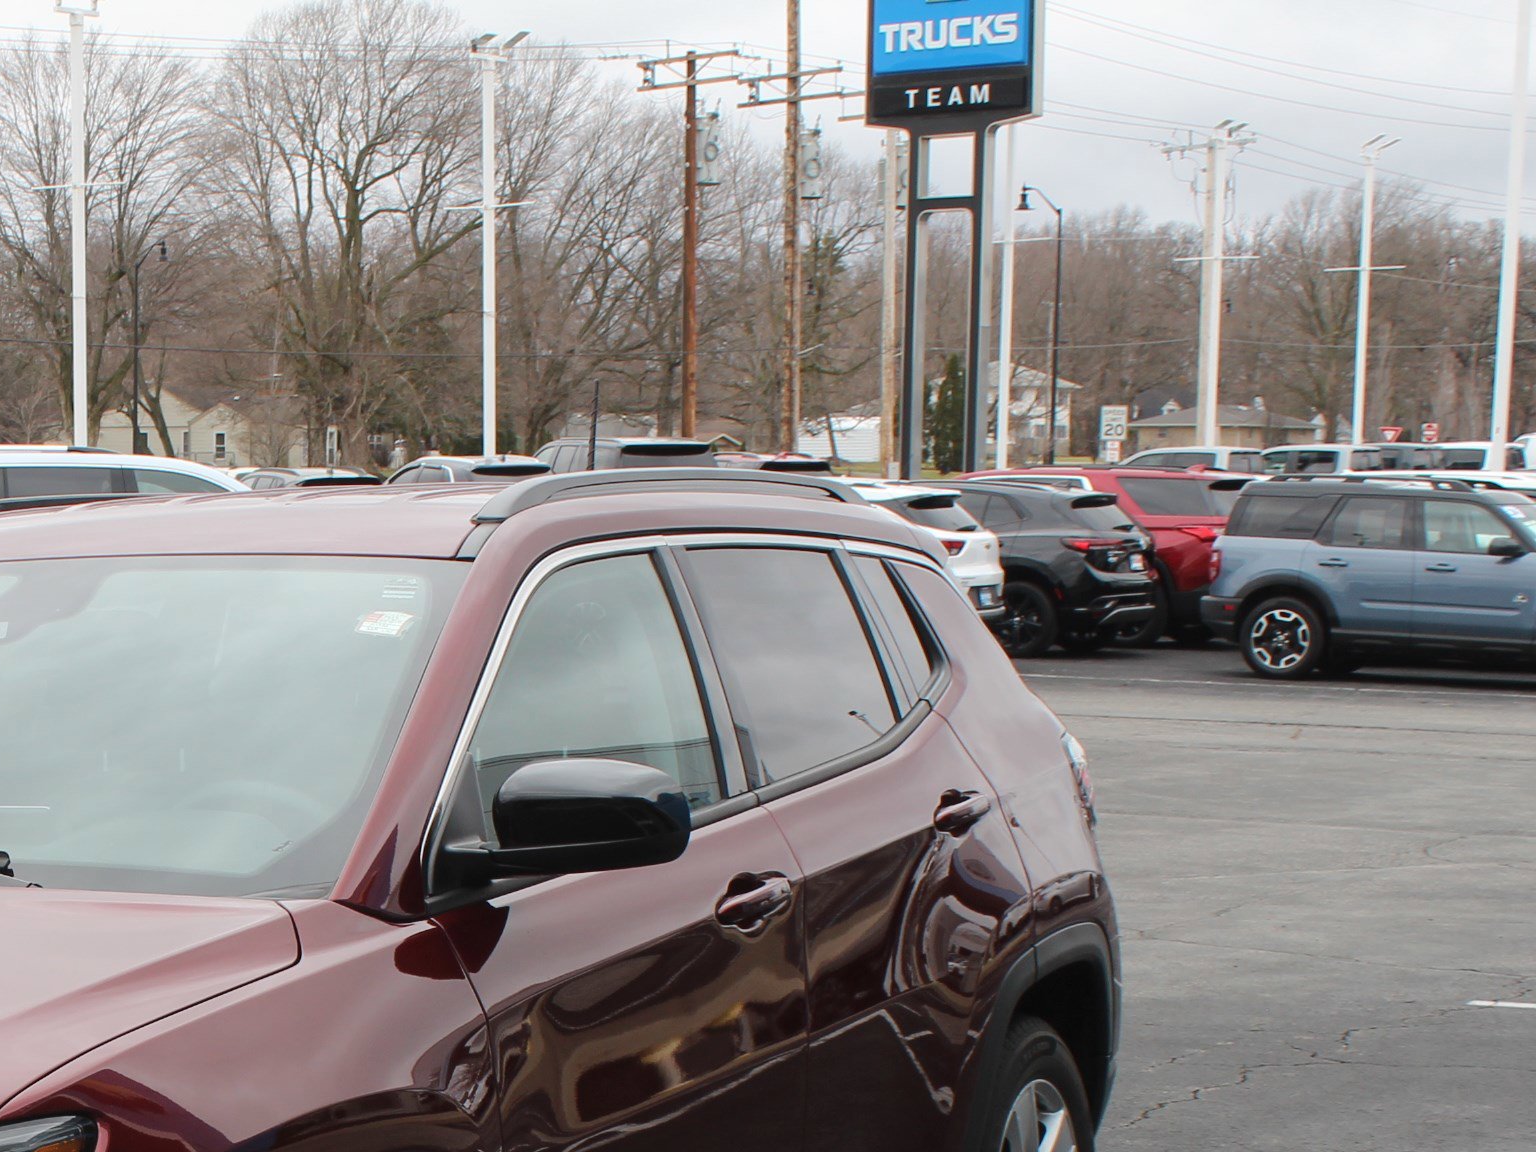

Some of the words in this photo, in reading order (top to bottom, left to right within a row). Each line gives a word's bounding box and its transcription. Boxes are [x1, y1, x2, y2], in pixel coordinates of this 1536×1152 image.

[879, 12, 1018, 53] TRUCKS
[905, 83, 991, 109] TEAM
[1104, 423, 1124, 436] 20
